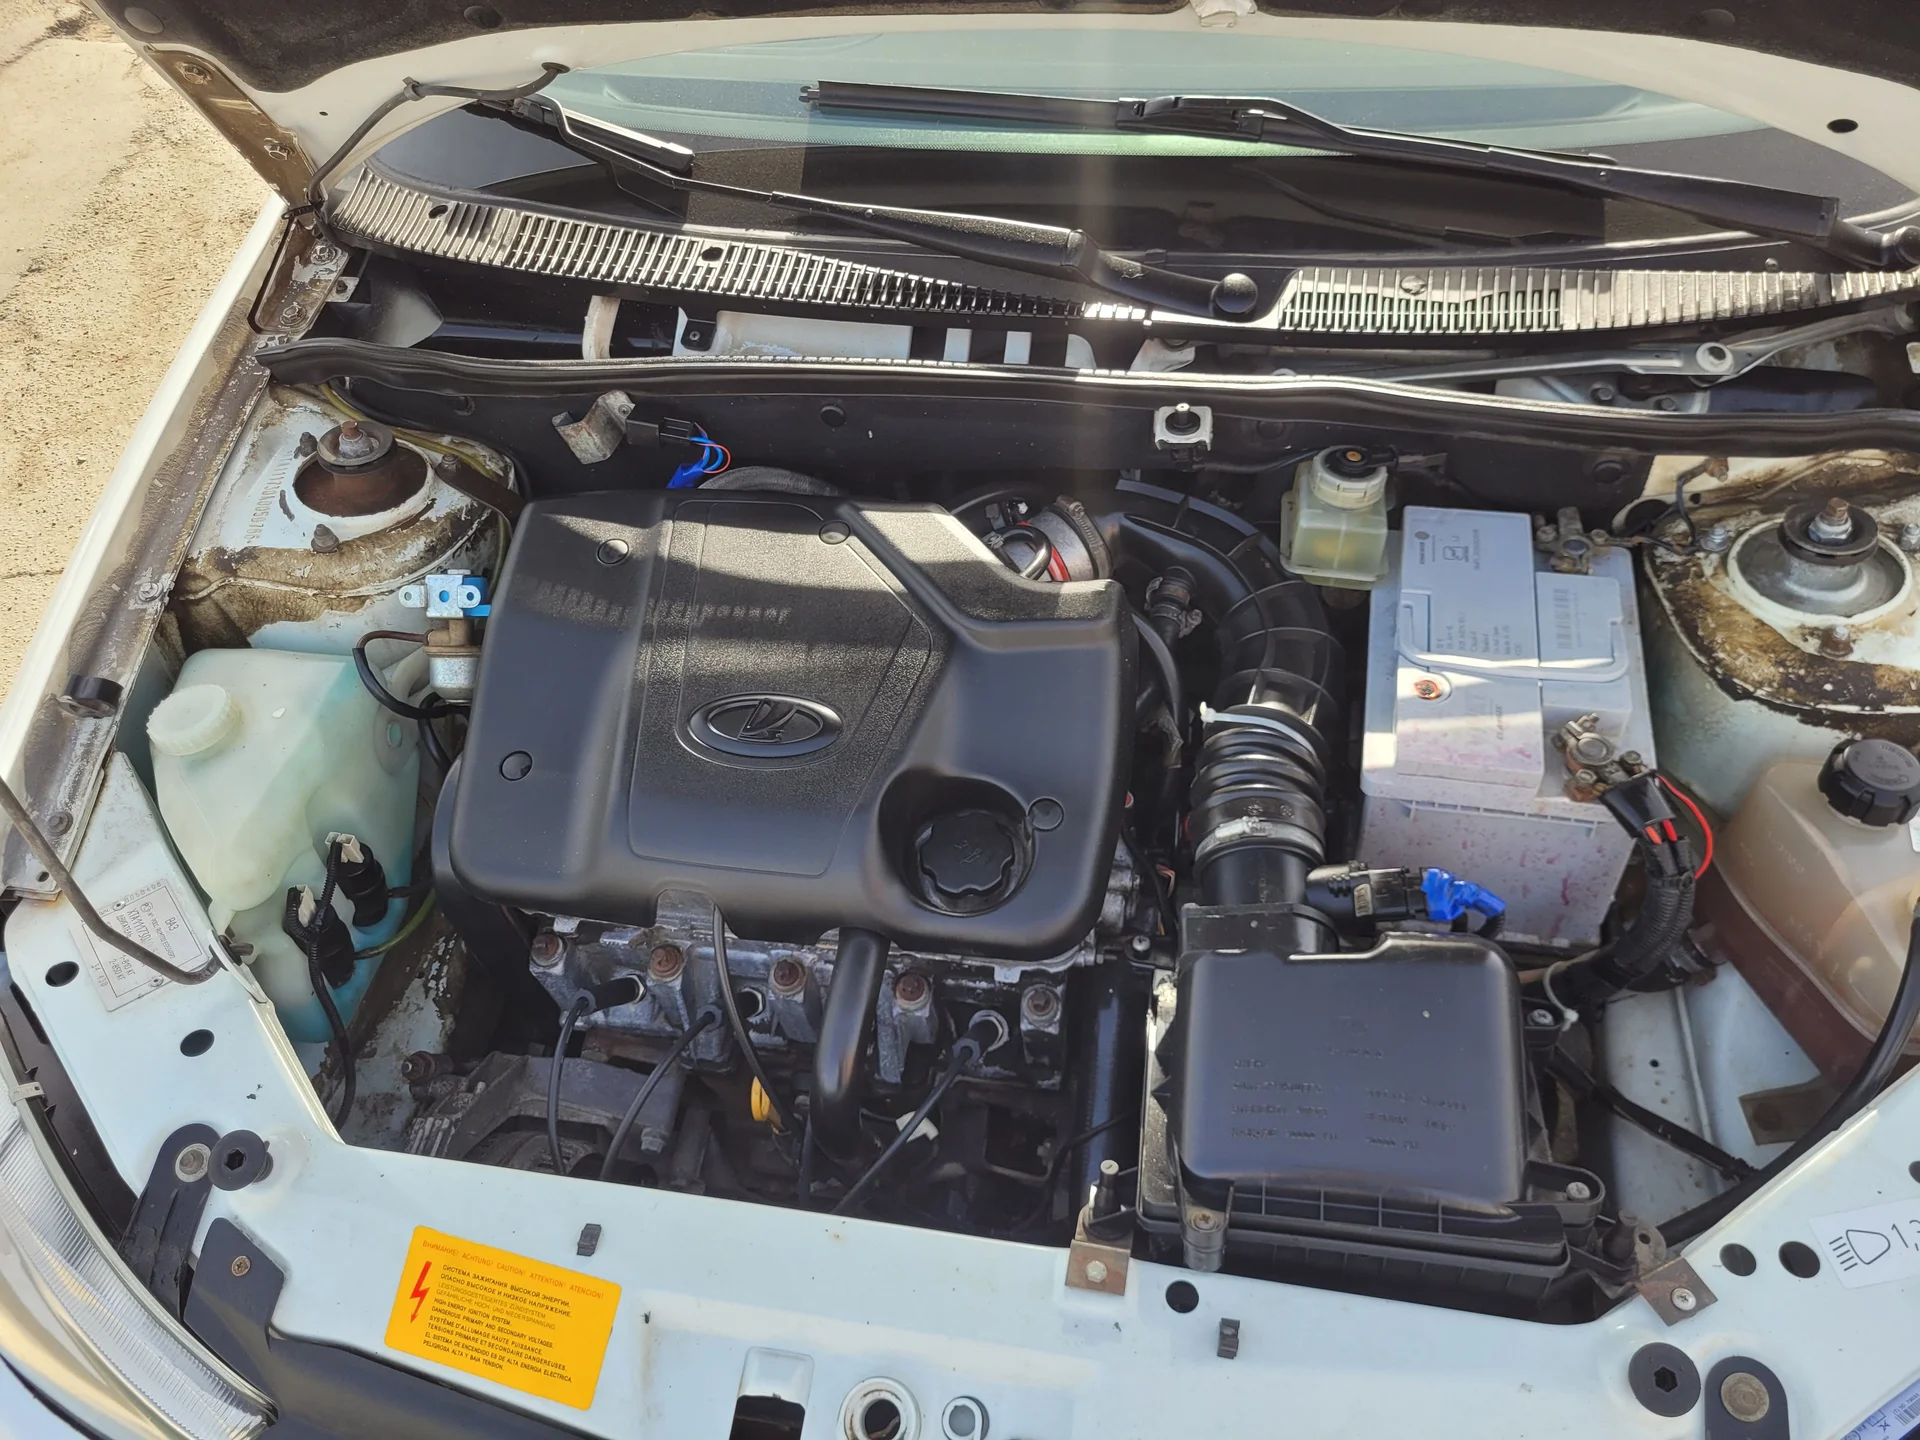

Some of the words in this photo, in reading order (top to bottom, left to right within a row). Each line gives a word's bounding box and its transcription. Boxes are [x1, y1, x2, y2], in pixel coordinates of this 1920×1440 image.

[443, 1264, 471, 1278] СИСТЕМА
[472, 1273, 508, 1289] ЗАЖИГАНИЯ
[510, 1284, 540, 1298] ВЫСОКОЙ
[541, 1293, 571, 1307] ЭНЕРГИИ.
[462, 1252, 494, 1267] ACHTUNG!
[496, 1262, 526, 1276] CAUTION!
[530, 1272, 566, 1288] ATTENTION!
[434, 1297, 466, 1312] HIGH-ENERGY
[468, 1308, 490, 1319] IGNITION
[440, 1273, 465, 1285] ОПАСНО
[466, 1281, 496, 1295] ВЫСОКОЕ
[503, 1292, 527, 1304] НИЗКОЕ
[529, 1299, 572, 1318] НАПРЯЖЕНИЕ.
[432, 1306, 461, 1319] DANGEROUS
[462, 1315, 483, 1326] PRIMARY
[485, 1322, 496, 1330] AND
[497, 1326, 526, 1340] SECONDARY
[423, 1339, 450, 1353] PELIGROSA
[451, 1349, 463, 1357] ALTA
[428, 1323, 454, 1336] TENSIONS
[488, 1342, 523, 1358] SECONDAIRE
[524, 1353, 567, 1372] DANGEREUSES.
[433, 1334, 453, 1345] SISTEMA
[462, 1343, 489, 1357] ENCENDIDO
[507, 1358, 519, 1366] ALTA
[491, 1334, 509, 1344] HAUTE
[511, 1340, 543, 1355] PUISSANCE.
